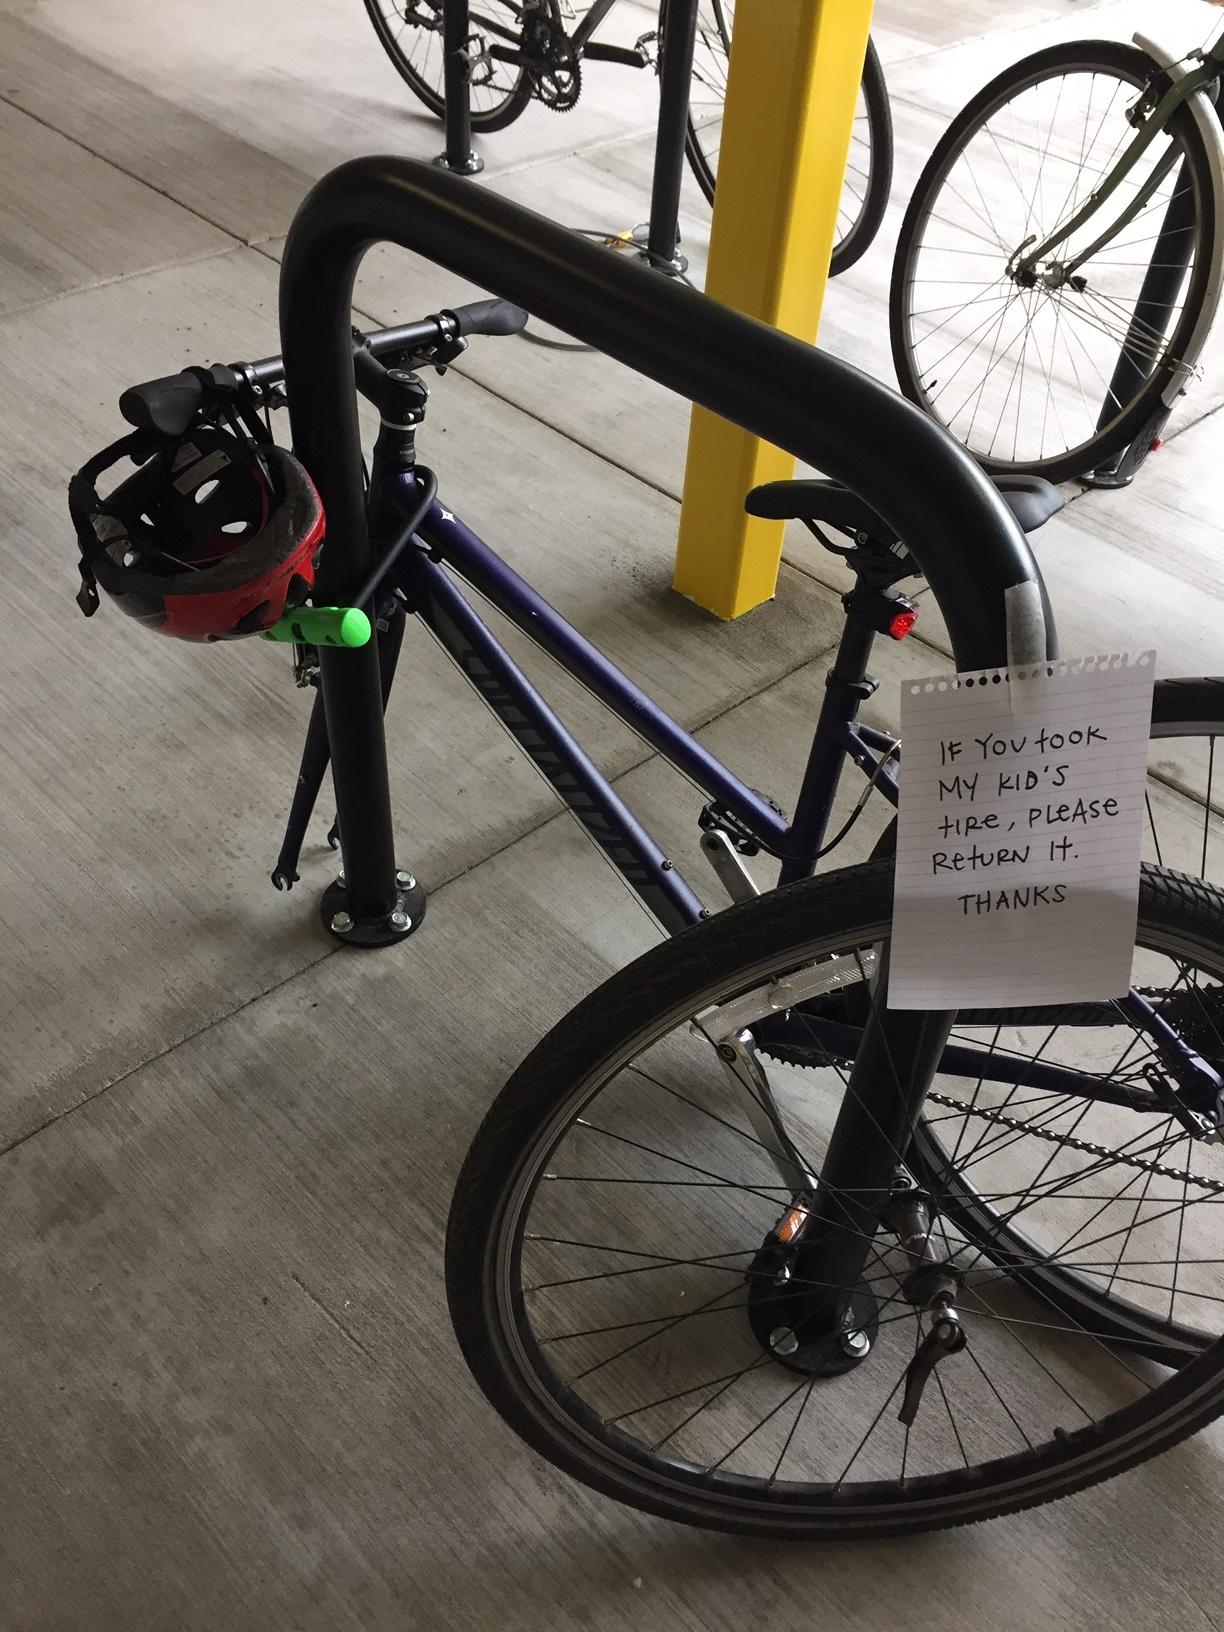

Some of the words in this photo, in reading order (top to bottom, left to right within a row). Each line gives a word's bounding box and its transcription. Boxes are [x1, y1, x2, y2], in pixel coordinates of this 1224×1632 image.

[940, 741, 963, 766] IF
[974, 732, 1028, 759] YOU
[938, 772, 979, 802] MY
[997, 764, 1069, 797] KID'S
[957, 884, 1068, 915] THANKS
